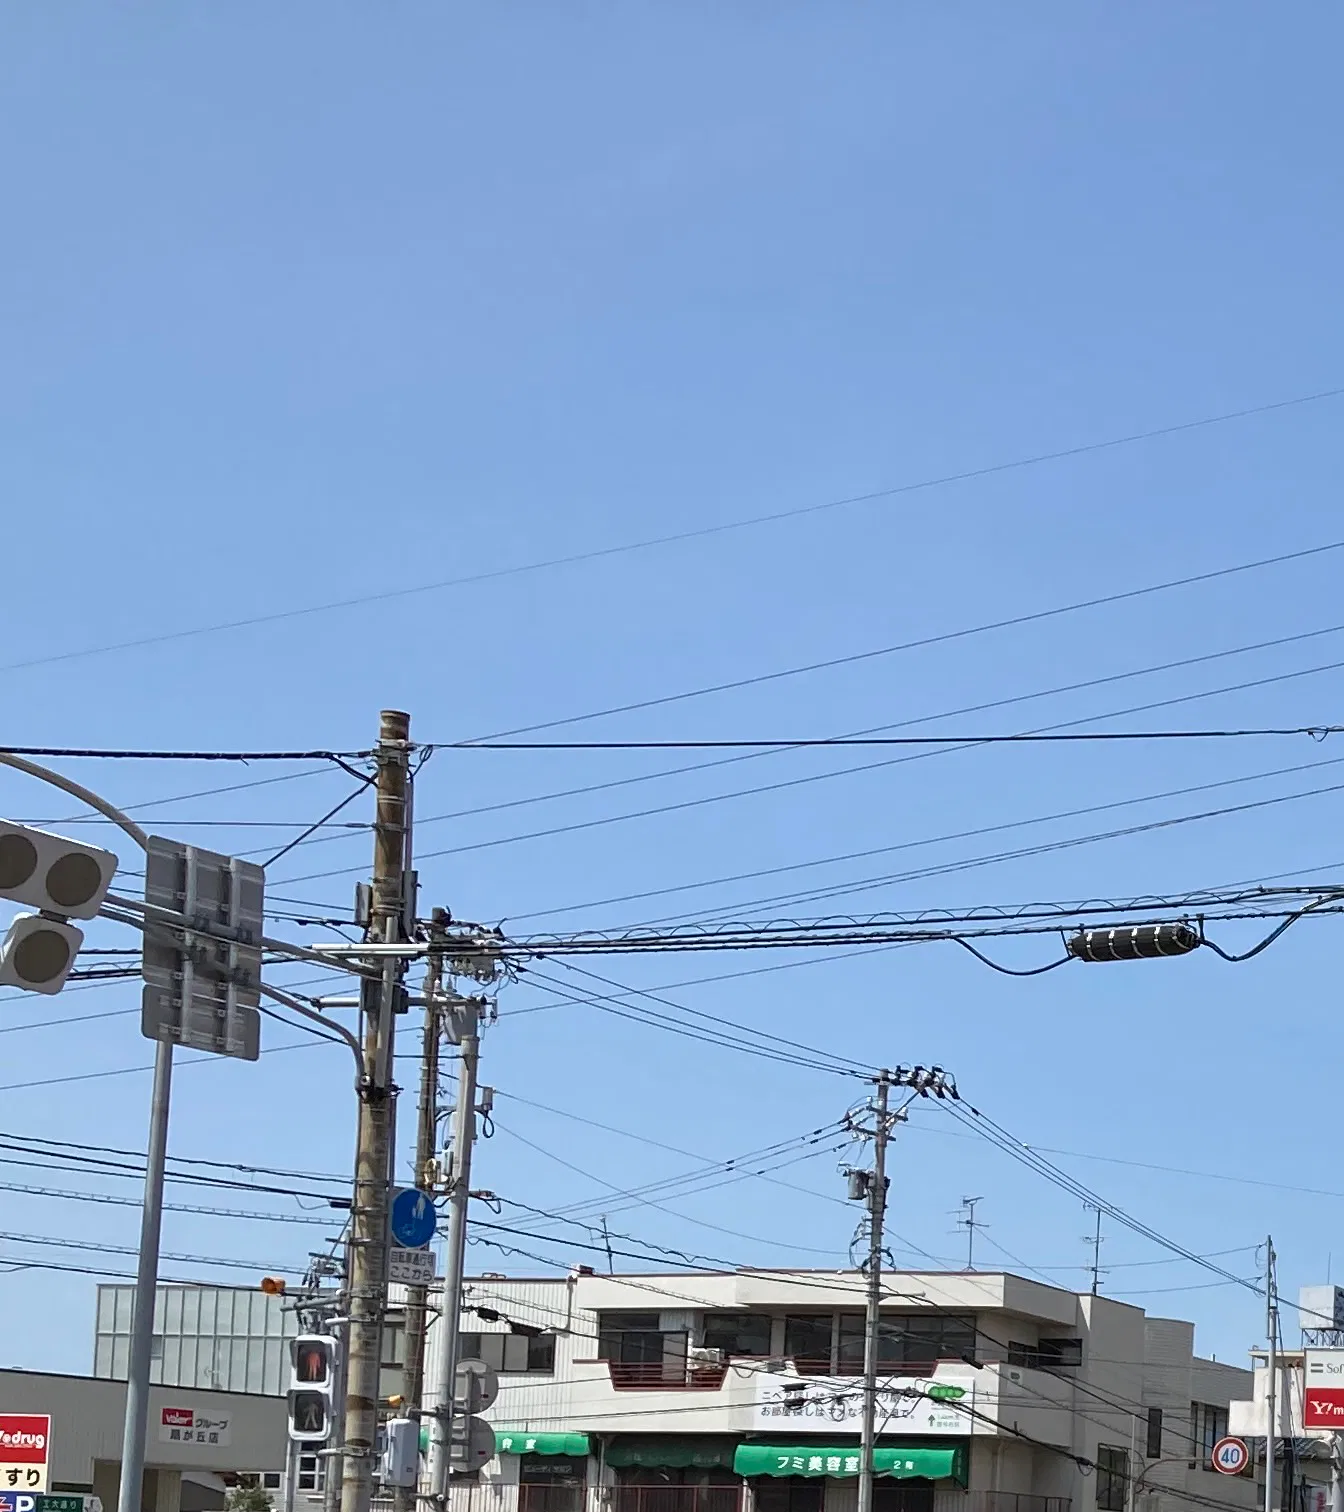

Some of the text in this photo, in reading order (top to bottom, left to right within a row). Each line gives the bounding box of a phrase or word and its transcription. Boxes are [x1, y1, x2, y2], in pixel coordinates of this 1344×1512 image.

[777, 1456, 860, 1473] フミ美容室
[1220, 1449, 1240, 1464] 40
[0, 1468, 40, 1487] すり
